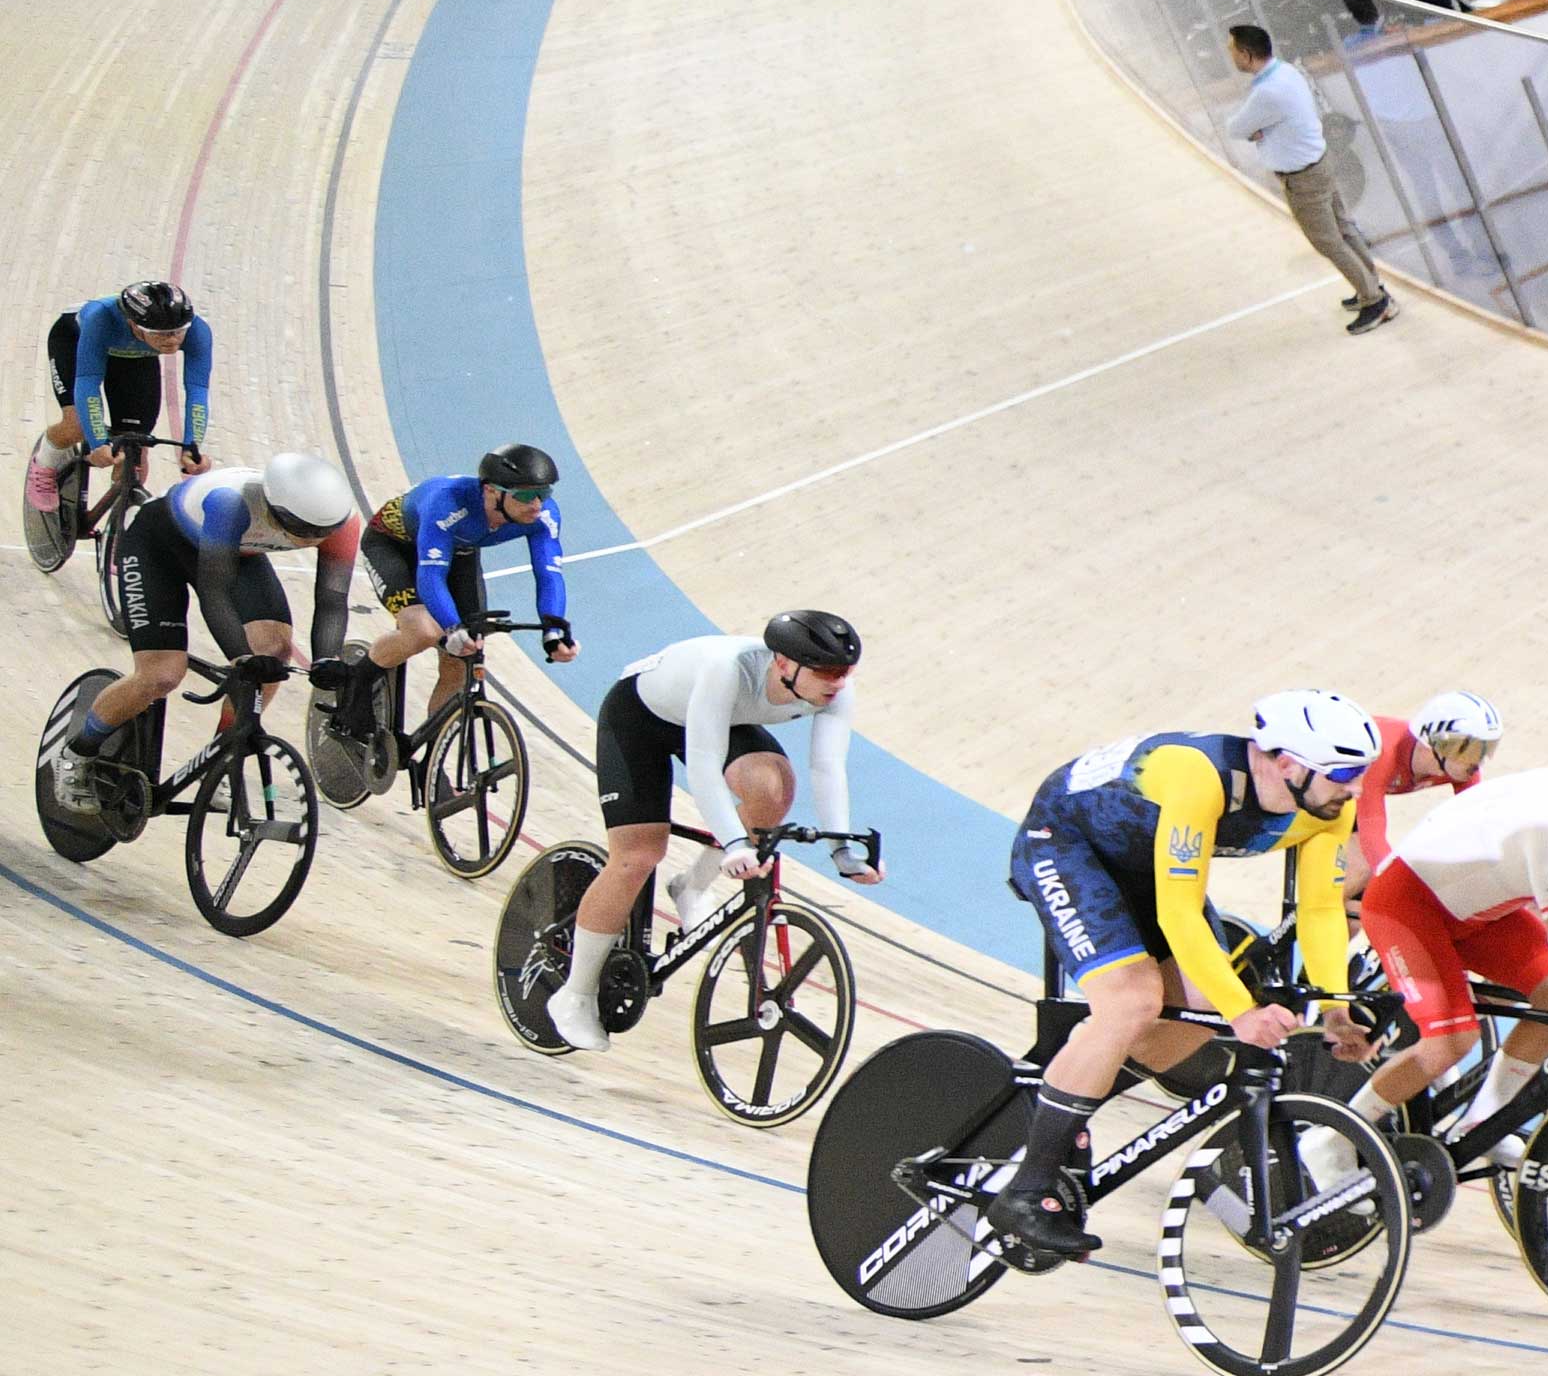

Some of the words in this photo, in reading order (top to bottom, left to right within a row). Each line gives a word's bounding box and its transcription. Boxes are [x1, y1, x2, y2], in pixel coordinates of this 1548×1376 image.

[87, 397, 108, 440] SWEDEN
[122, 555, 150, 630] SLOVAKIA
[1420, 719, 1456, 737] HJC
[174, 739, 221, 786] BMC
[1033, 858, 1096, 962] UKRAINE
[722, 1085, 809, 1119] CORIMA
[1091, 1081, 1228, 1188] PINARELLO
